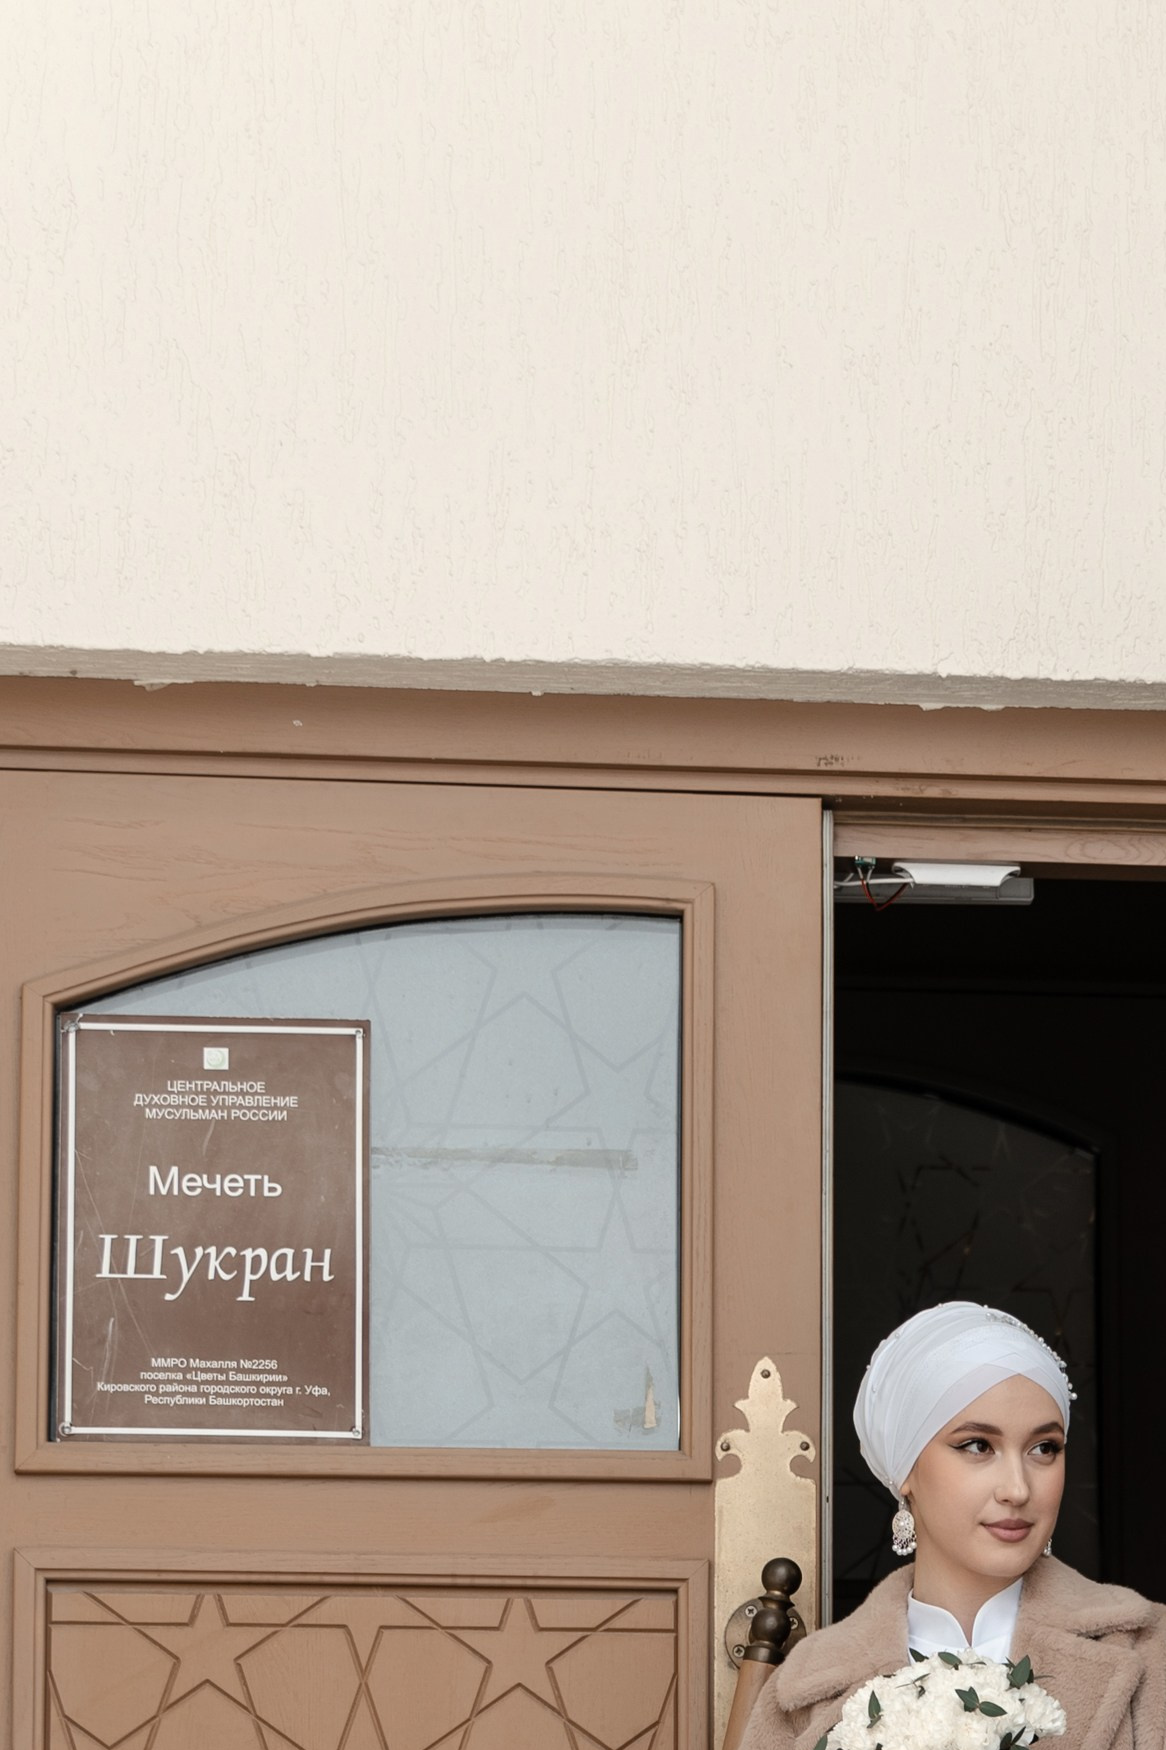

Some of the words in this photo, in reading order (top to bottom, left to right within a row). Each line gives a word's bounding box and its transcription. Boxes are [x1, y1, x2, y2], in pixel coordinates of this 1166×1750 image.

[167, 1080, 265, 1093] ЦЕНТРАЛЬНОЕ
[133, 1093, 207, 1107] ДУХОВНОЕ
[210, 1095, 299, 1108] УПРАВЛЕНИЕ
[144, 1108, 228, 1121] МУСУЛЬМАН
[231, 1109, 288, 1122] РОССИИ
[148, 1166, 283, 1197] Мечеть
[95, 1235, 335, 1301] Шукран
[151, 1358, 187, 1368] ММРО
[190, 1358, 238, 1369] Махалля
[239, 1359, 278, 1370] №2256
[140, 1371, 183, 1380] поселка
[186, 1370, 226, 1382] «Цветы
[229, 1371, 288, 1383] Башкирии»
[97, 1381, 156, 1393] Кировского
[158, 1383, 197, 1394] района
[200, 1385, 257, 1395] городского
[259, 1385, 293, 1397] округа
[295, 1386, 302, 1395] г.
[304, 1385, 331, 1397] Уфа,
[144, 1394, 206, 1406] Республики
[209, 1395, 284, 1407] Башкортостан
